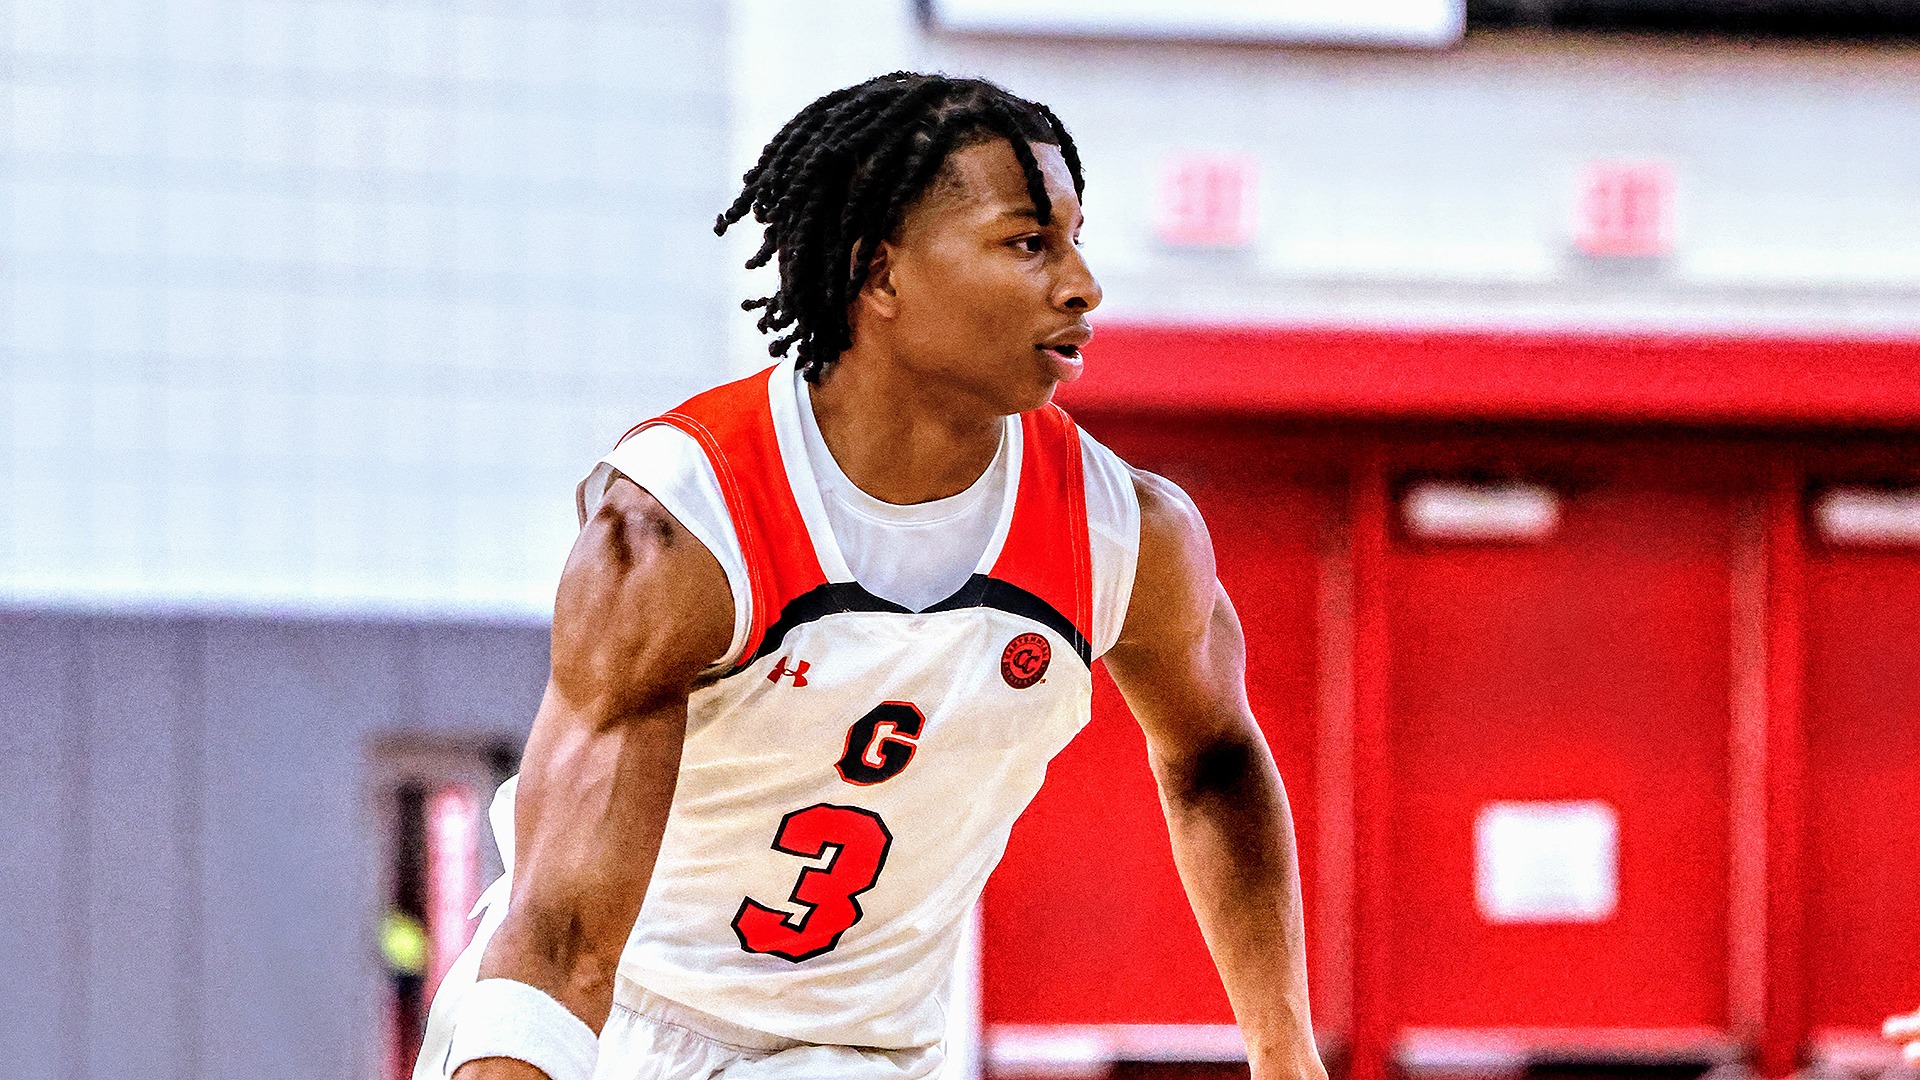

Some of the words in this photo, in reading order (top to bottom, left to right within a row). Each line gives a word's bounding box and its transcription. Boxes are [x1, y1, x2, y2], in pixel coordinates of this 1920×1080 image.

[1013, 649, 1040, 674] CC
[834, 700, 926, 786] G
[731, 803, 893, 963] 3
